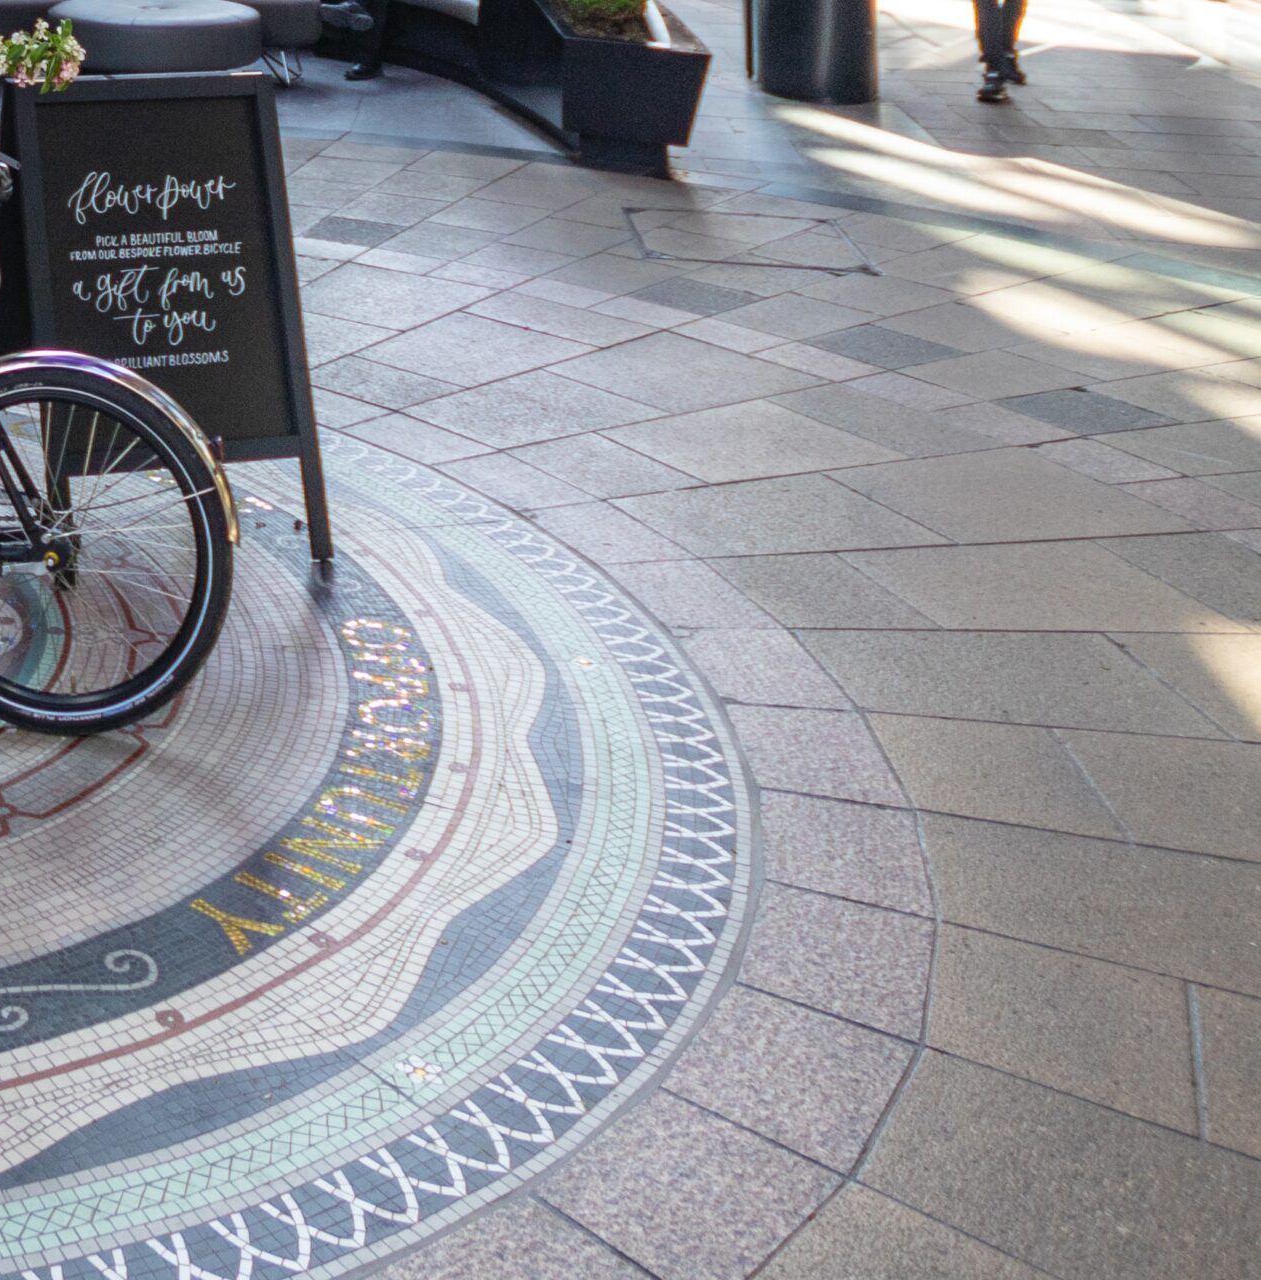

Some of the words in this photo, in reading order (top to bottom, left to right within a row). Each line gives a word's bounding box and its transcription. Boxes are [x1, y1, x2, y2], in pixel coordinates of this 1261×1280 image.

[68, 171, 158, 225] flower
[156, 174, 237, 221] power
[70, 249, 98, 262] FROM
[98, 248, 118, 260] OUR
[118, 246, 162, 259] BESPOKE
[163, 244, 203, 257] FLOWER
[203, 241, 243, 256] BICYCLE
[95, 234, 120, 248] PICK
[120, 234, 128, 246] A
[129, 231, 185, 247] BEAUTIFUL
[186, 229, 219, 243] BLOOM
[72, 280, 91, 301] a
[95, 264, 160, 312] gift
[158, 267, 215, 311] from
[221, 266, 247, 296] us
[112, 307, 161, 345] to
[163, 310, 217, 346] you
[190, 618, 435, 956] OPPORTUNITY
